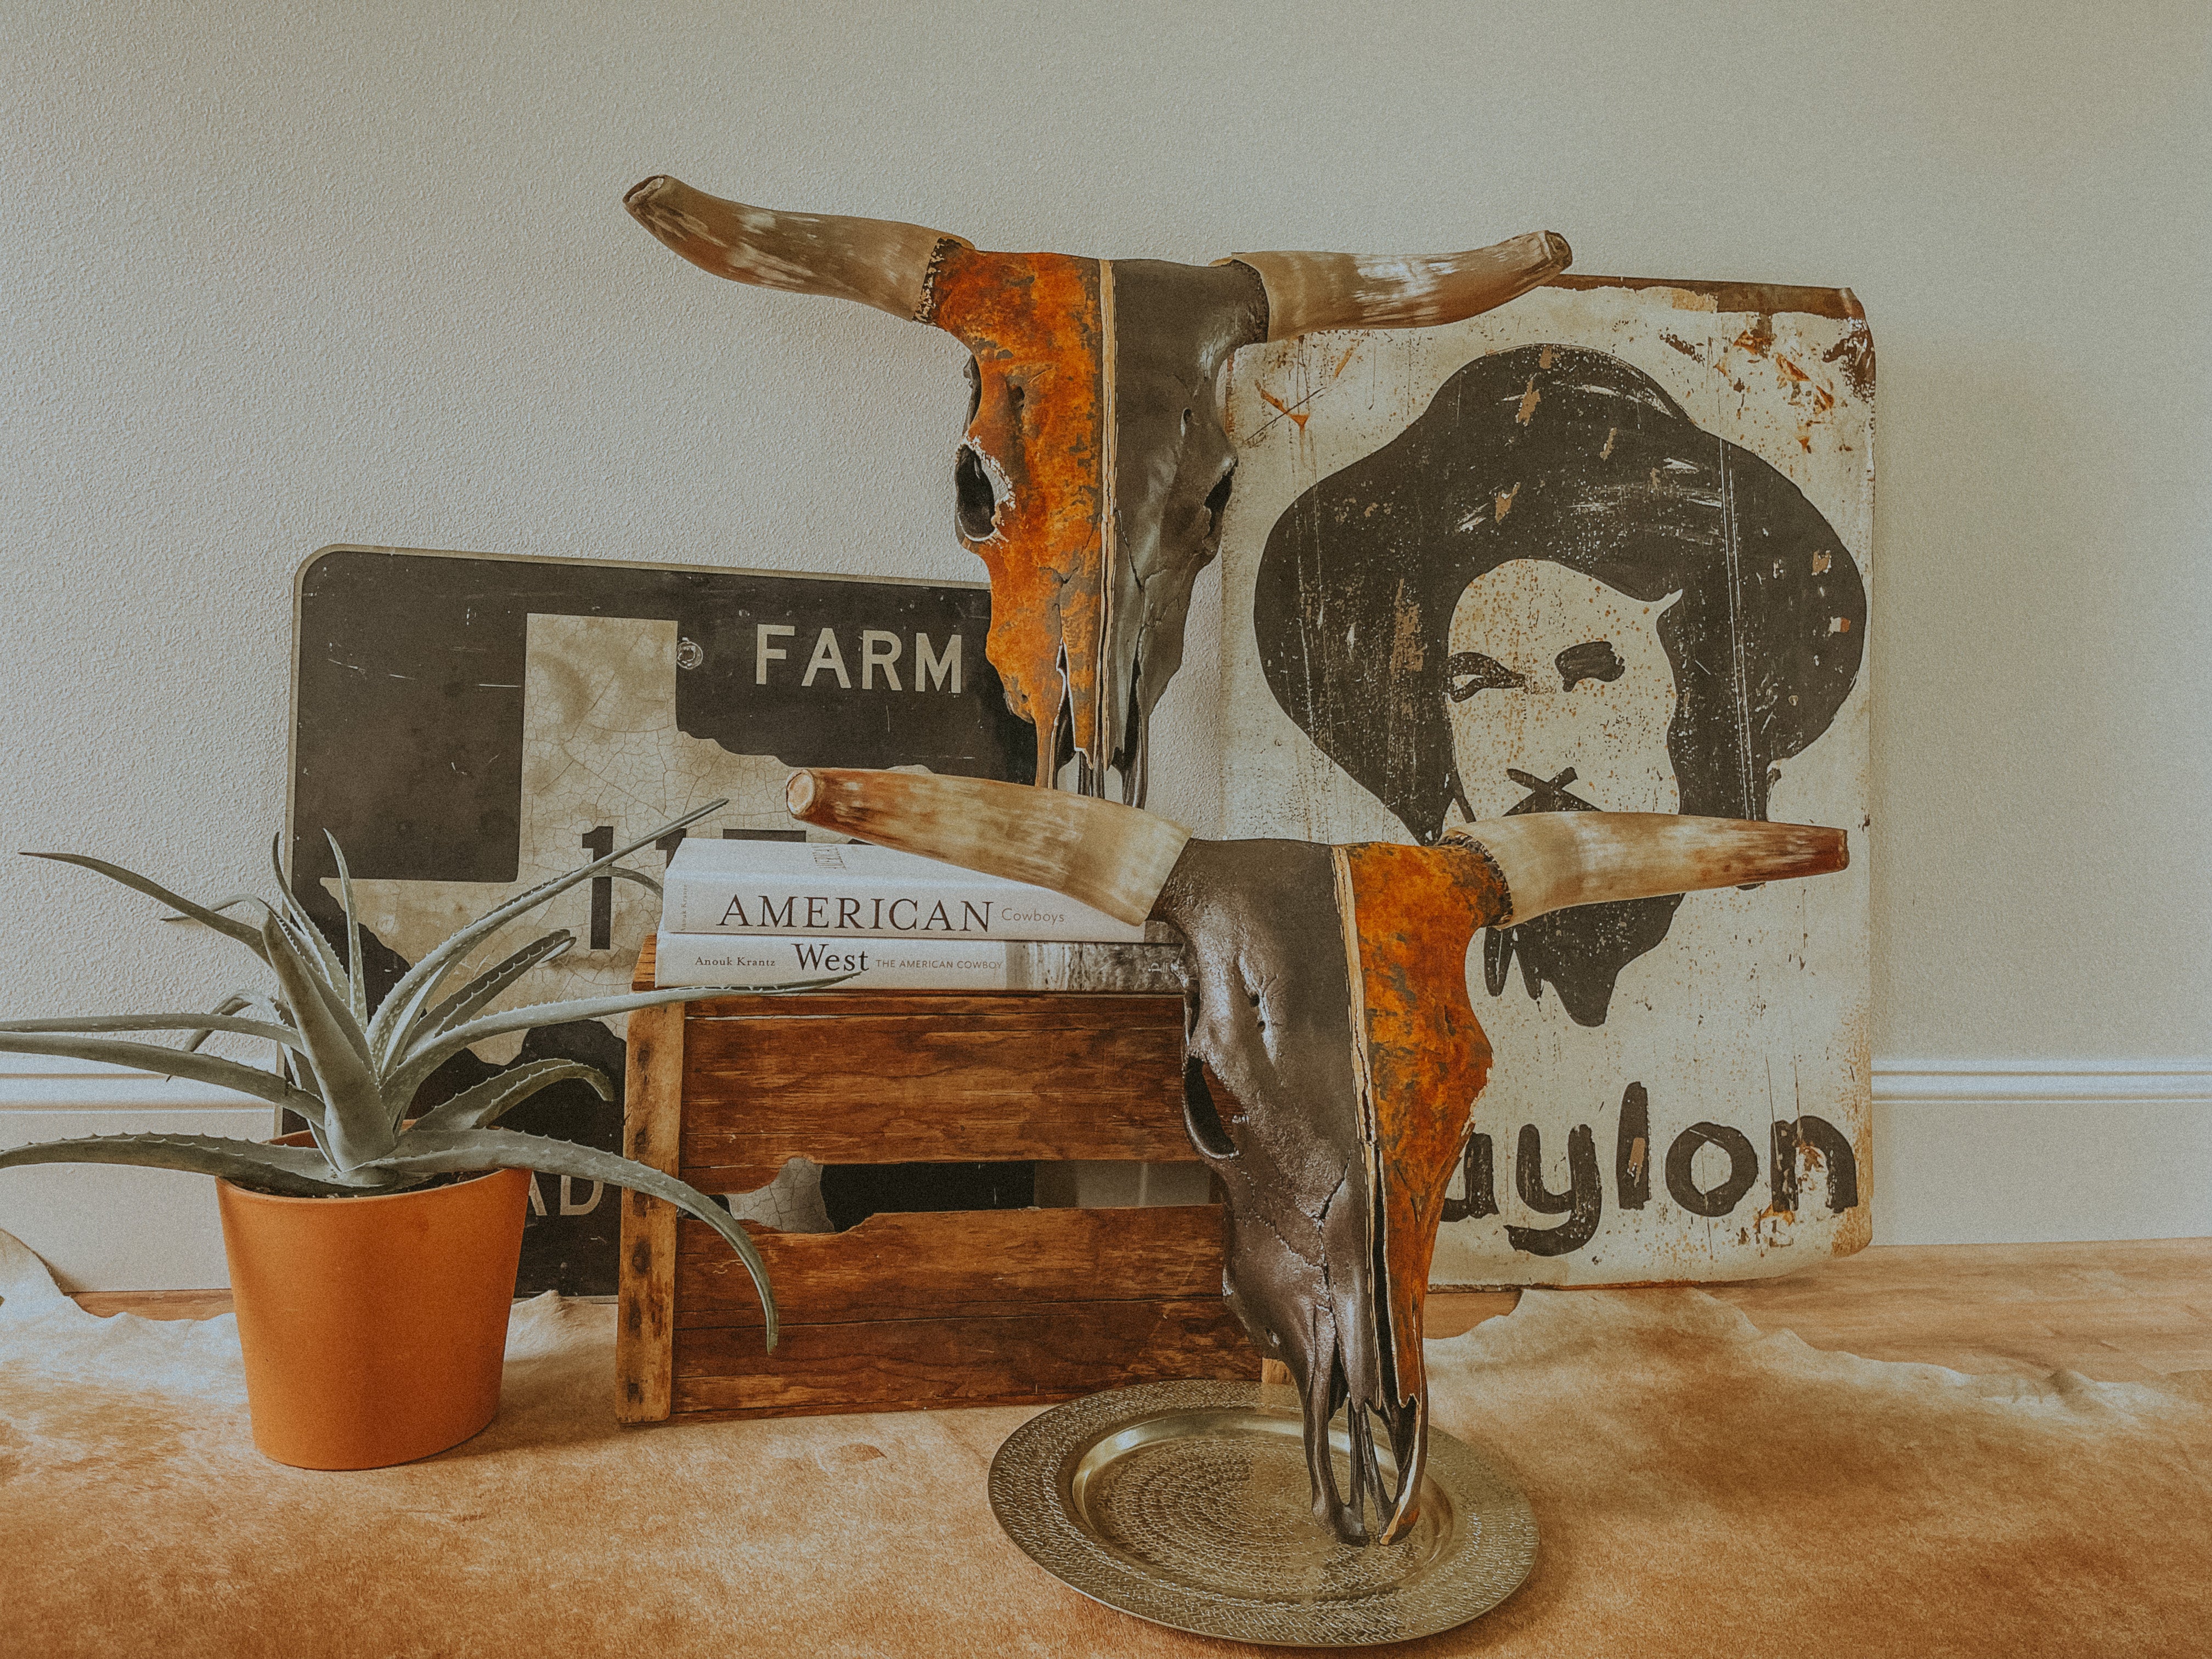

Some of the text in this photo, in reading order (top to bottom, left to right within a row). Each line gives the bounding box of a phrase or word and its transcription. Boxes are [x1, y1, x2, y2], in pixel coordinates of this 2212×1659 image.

[756, 624, 962, 693] FARM
[716, 894, 1065, 932] AMERICAN Cowboys
[695, 943, 1003, 972] Anouk Krantz West THE AMERICAN COWBOY
